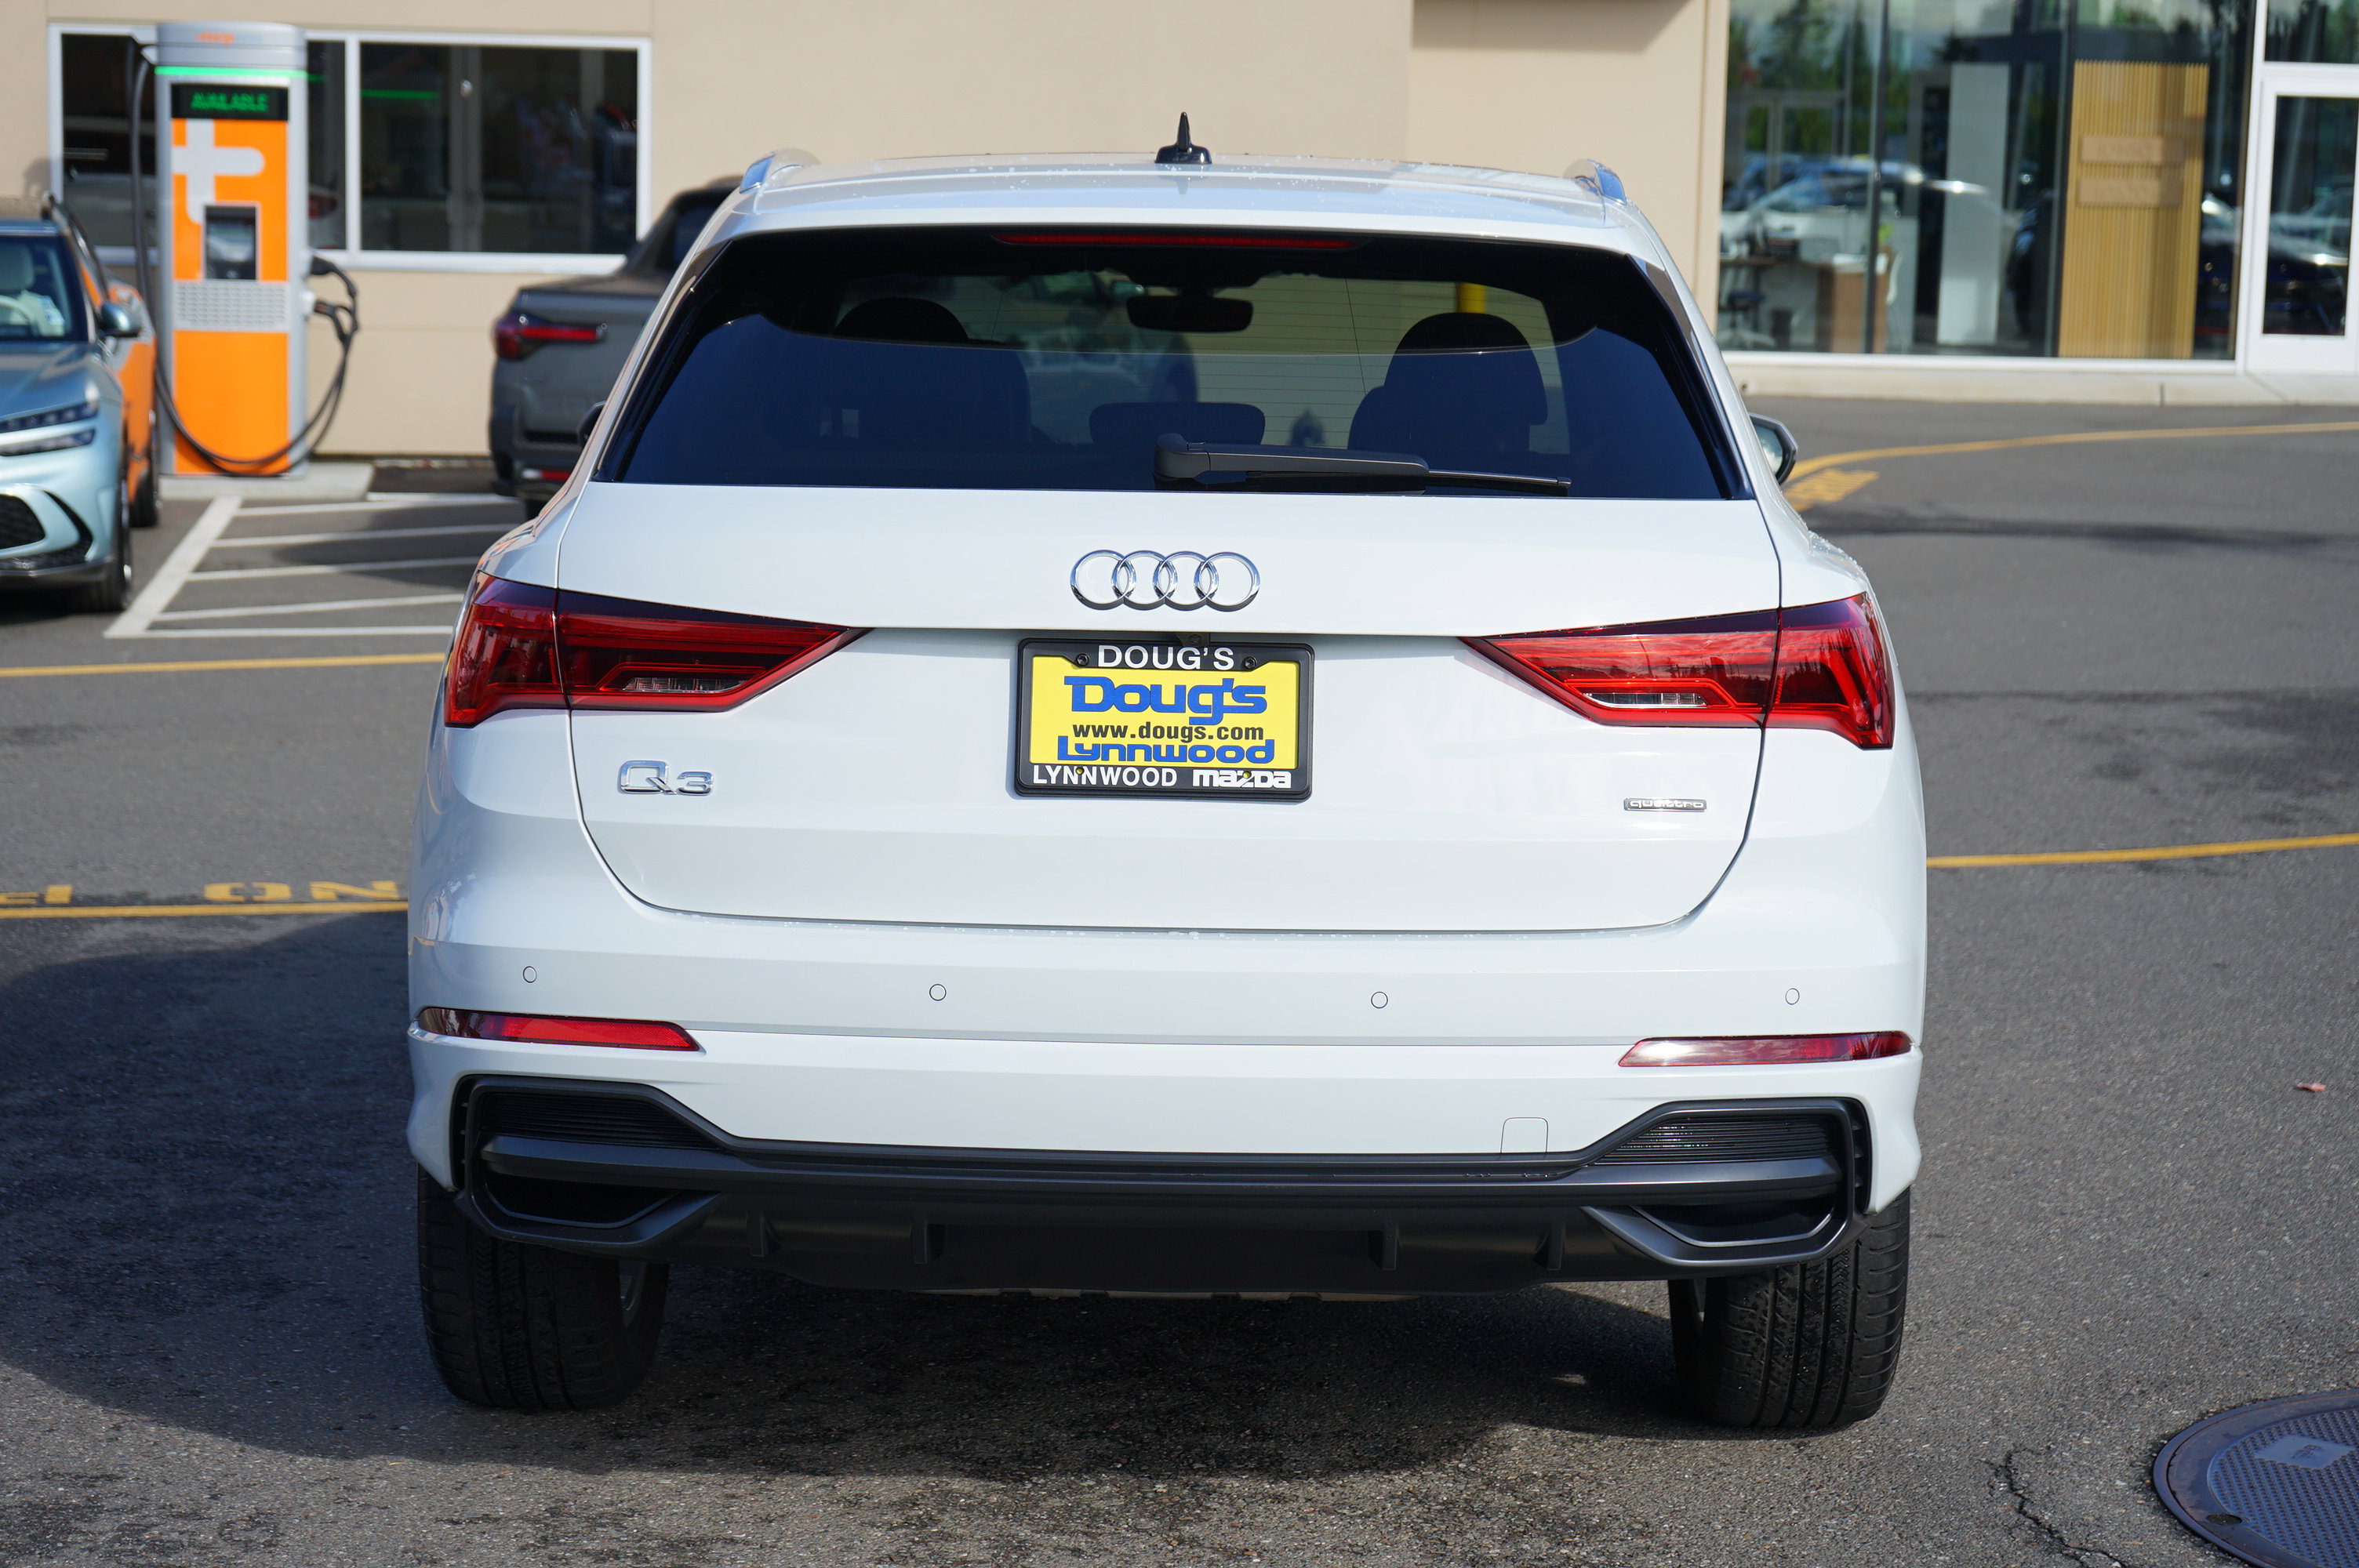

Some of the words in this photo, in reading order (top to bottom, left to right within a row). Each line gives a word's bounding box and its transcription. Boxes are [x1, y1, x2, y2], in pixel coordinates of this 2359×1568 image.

[1098, 644, 1235, 670] DOUG'S
[1063, 676, 1267, 725] Doug's
[1072, 722, 1264, 742] www.dougs.com
[1057, 735, 1275, 764] Lynnwood
[618, 760, 714, 797] Q3
[1032, 764, 1177, 786] LYNNWOOD
[1629, 799, 1704, 809] quattro
